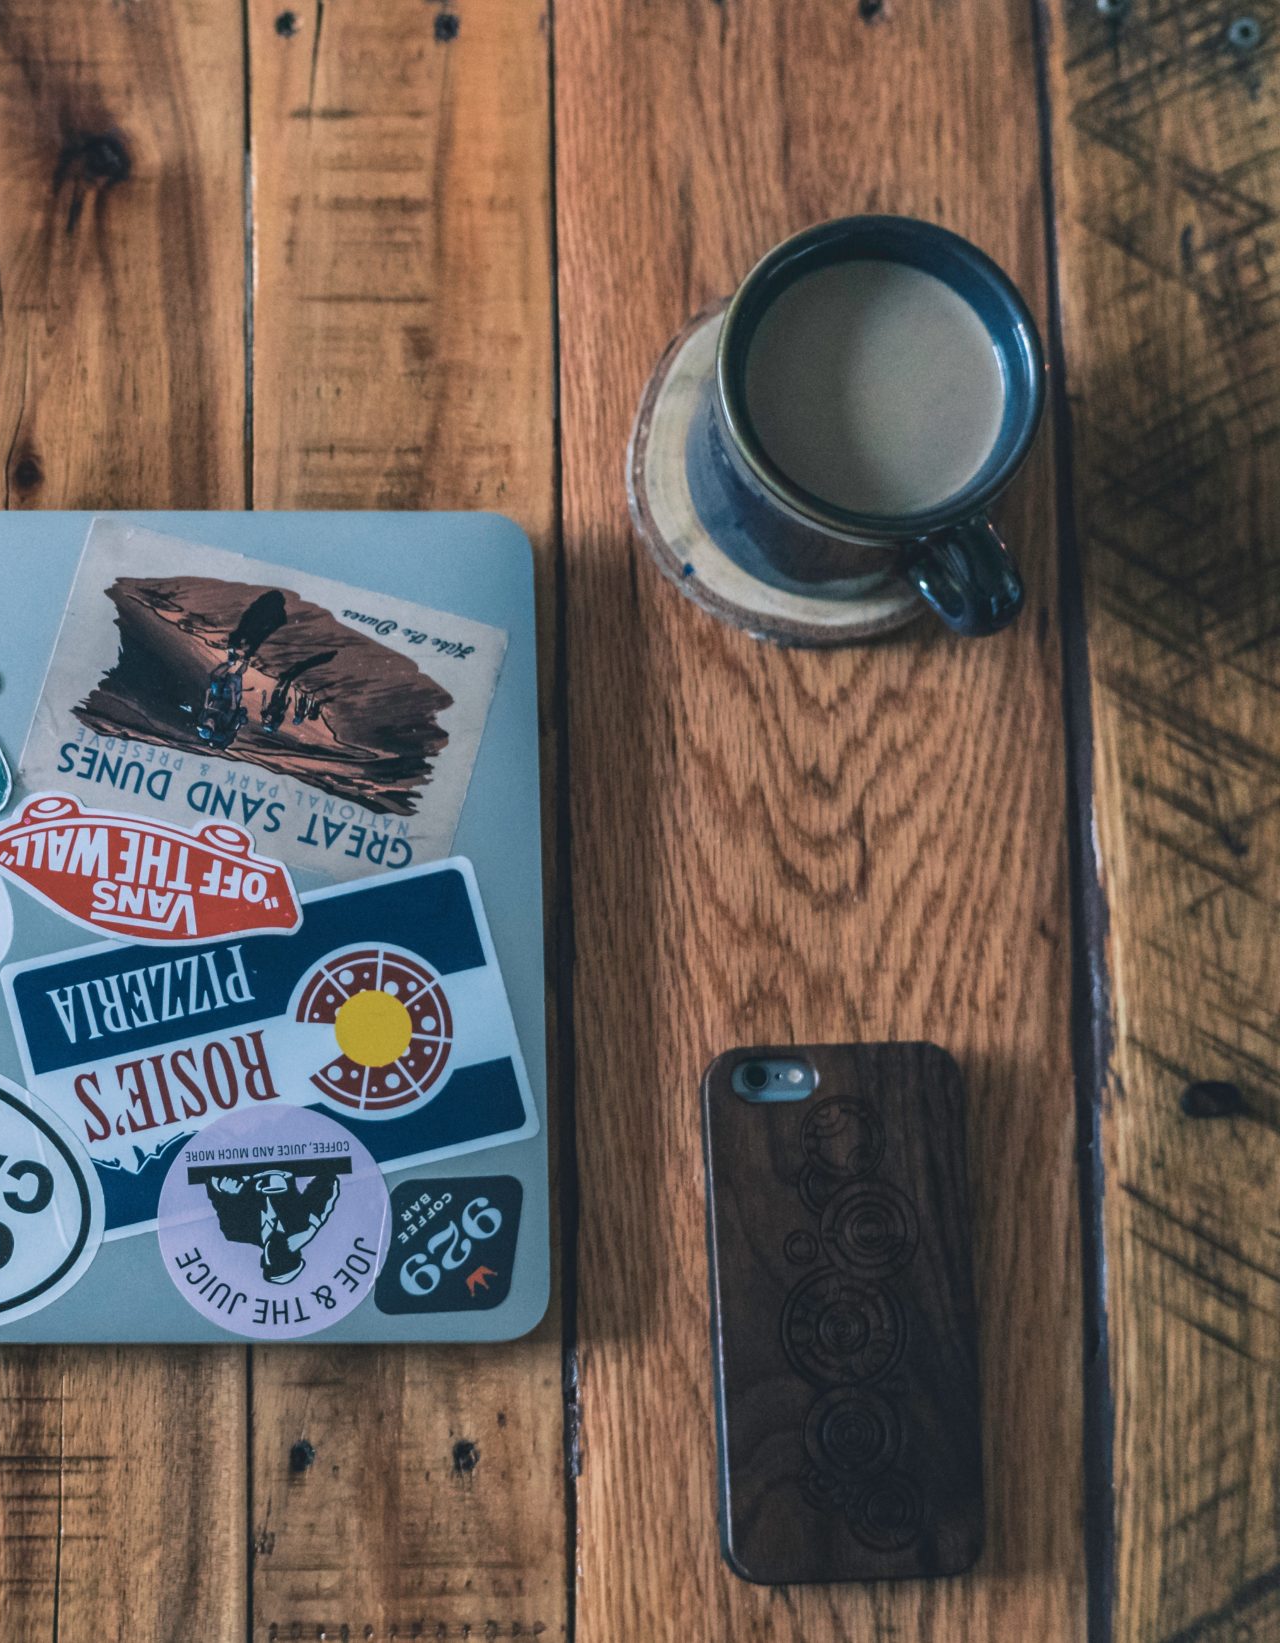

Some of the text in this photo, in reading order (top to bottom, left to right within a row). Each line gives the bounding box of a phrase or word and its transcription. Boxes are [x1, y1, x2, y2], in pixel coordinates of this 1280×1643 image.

[341, 610, 475, 660] Hike the Dunes
[57, 742, 413, 869] GREAT SAND DUNES
[75, 728, 409, 837] NATIONAL PARK & PRESERVE
[114, 829, 192, 892] THE
[199, 859, 279, 911] "OFF
[90, 880, 198, 936] VANS
[45, 944, 256, 1044] PIZZERIA
[73, 1029, 281, 1143] ROSIE'S
[184, 1140, 350, 1162] COFFEE, JUICE AND MUCH MORE
[397, 1192, 453, 1244] COFFEE
[400, 1193, 432, 1222] BAR
[399, 1197, 502, 1296] 929
[174, 1237, 377, 1325] JOE & THE JUICE
